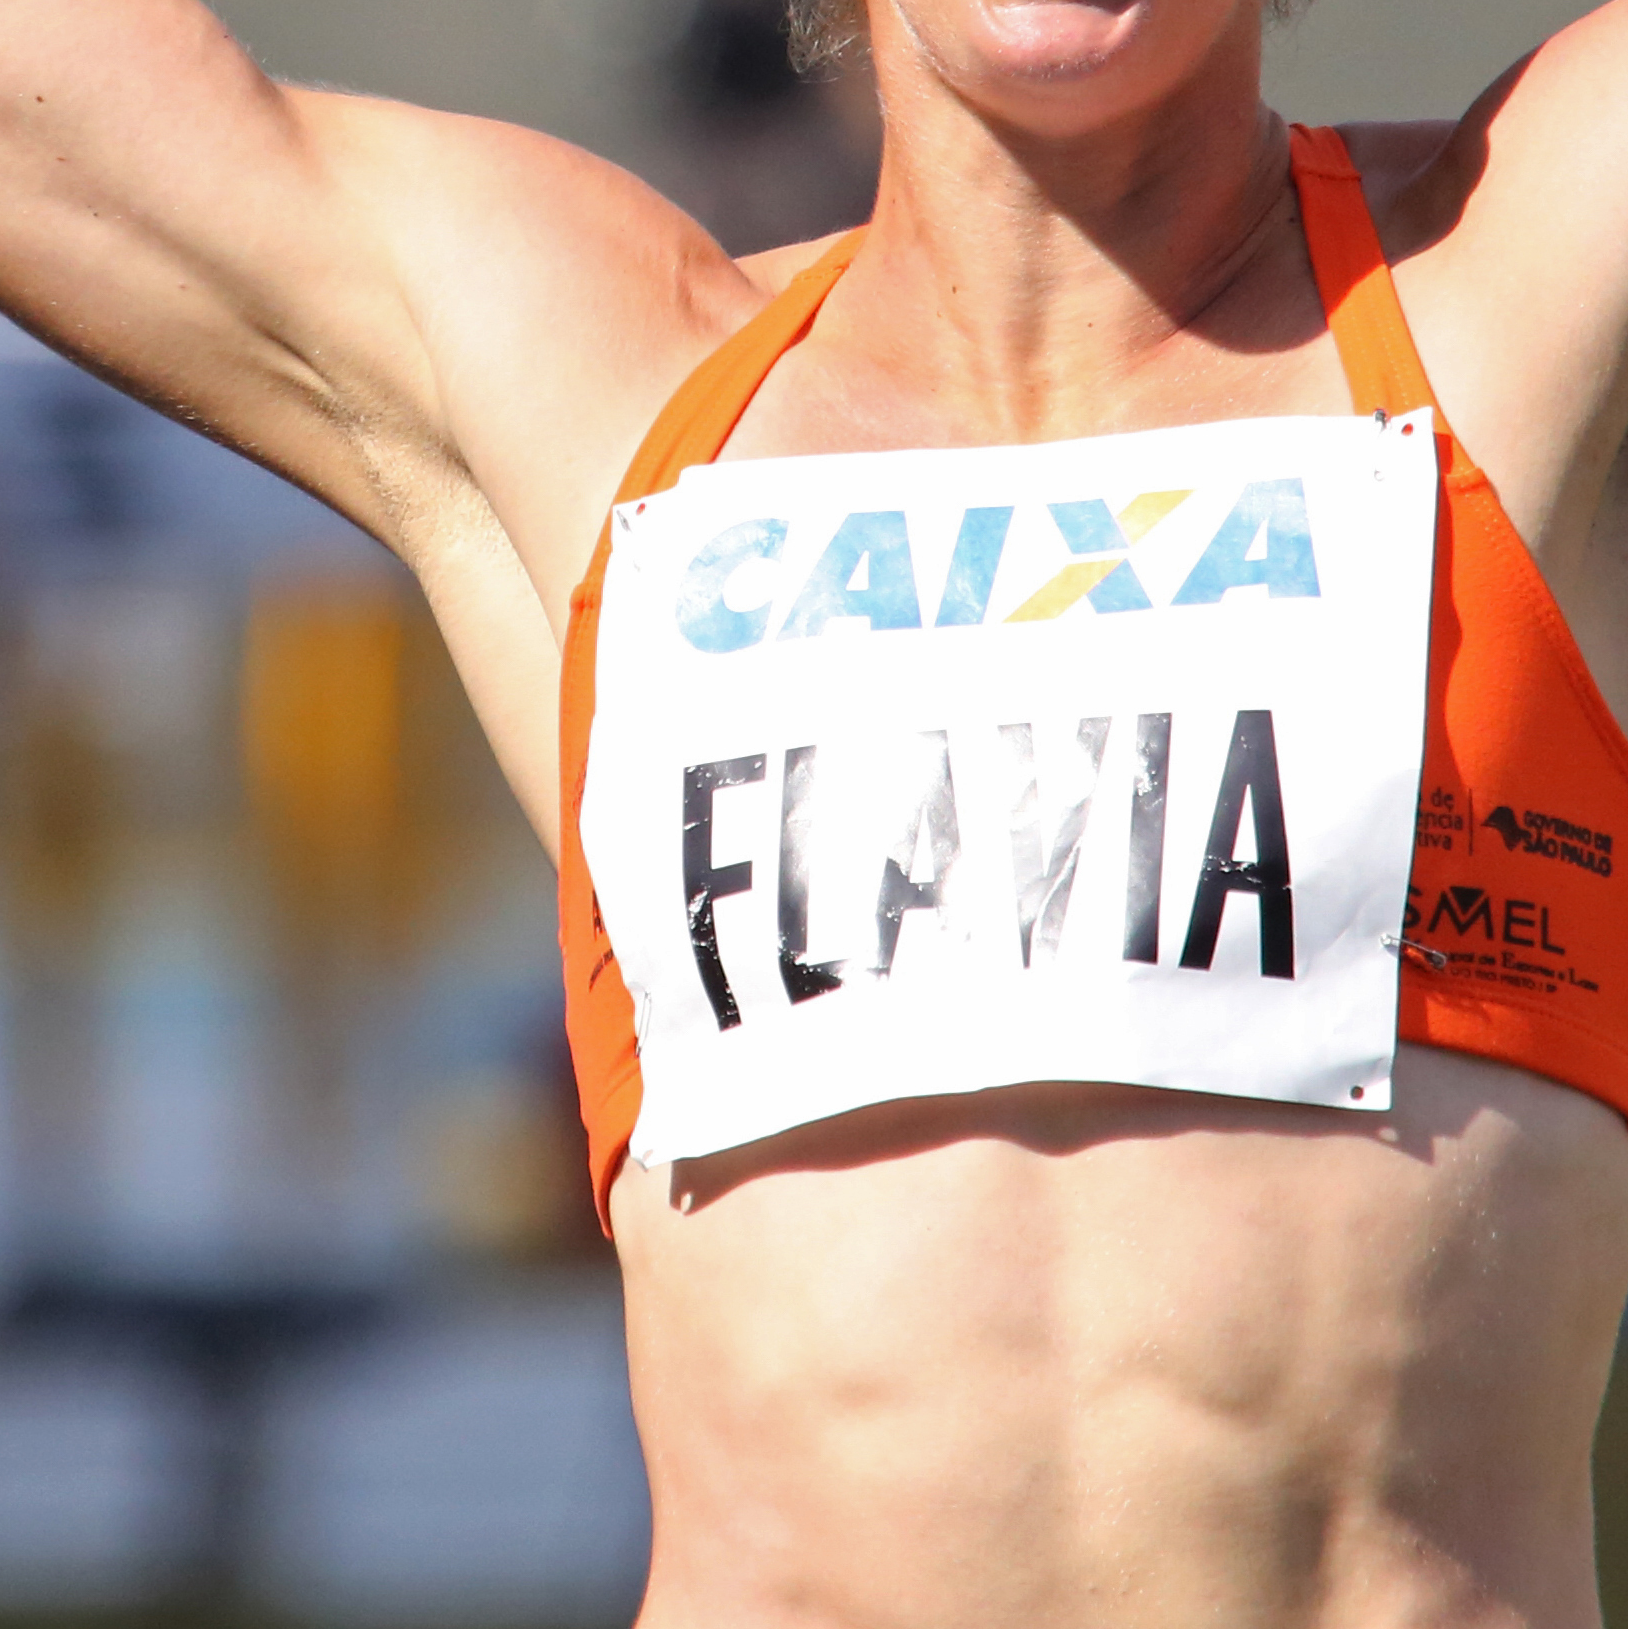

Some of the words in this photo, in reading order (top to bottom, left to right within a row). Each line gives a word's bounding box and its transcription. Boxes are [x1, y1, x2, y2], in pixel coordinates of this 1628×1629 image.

[674, 476, 1322, 654] CAIXA
[682, 709, 1296, 1032] FLAVIA
[1524, 810, 1591, 845] GOVERNO
[1593, 832, 1613, 856] DE
[1560, 841, 1613, 878] PAULO
